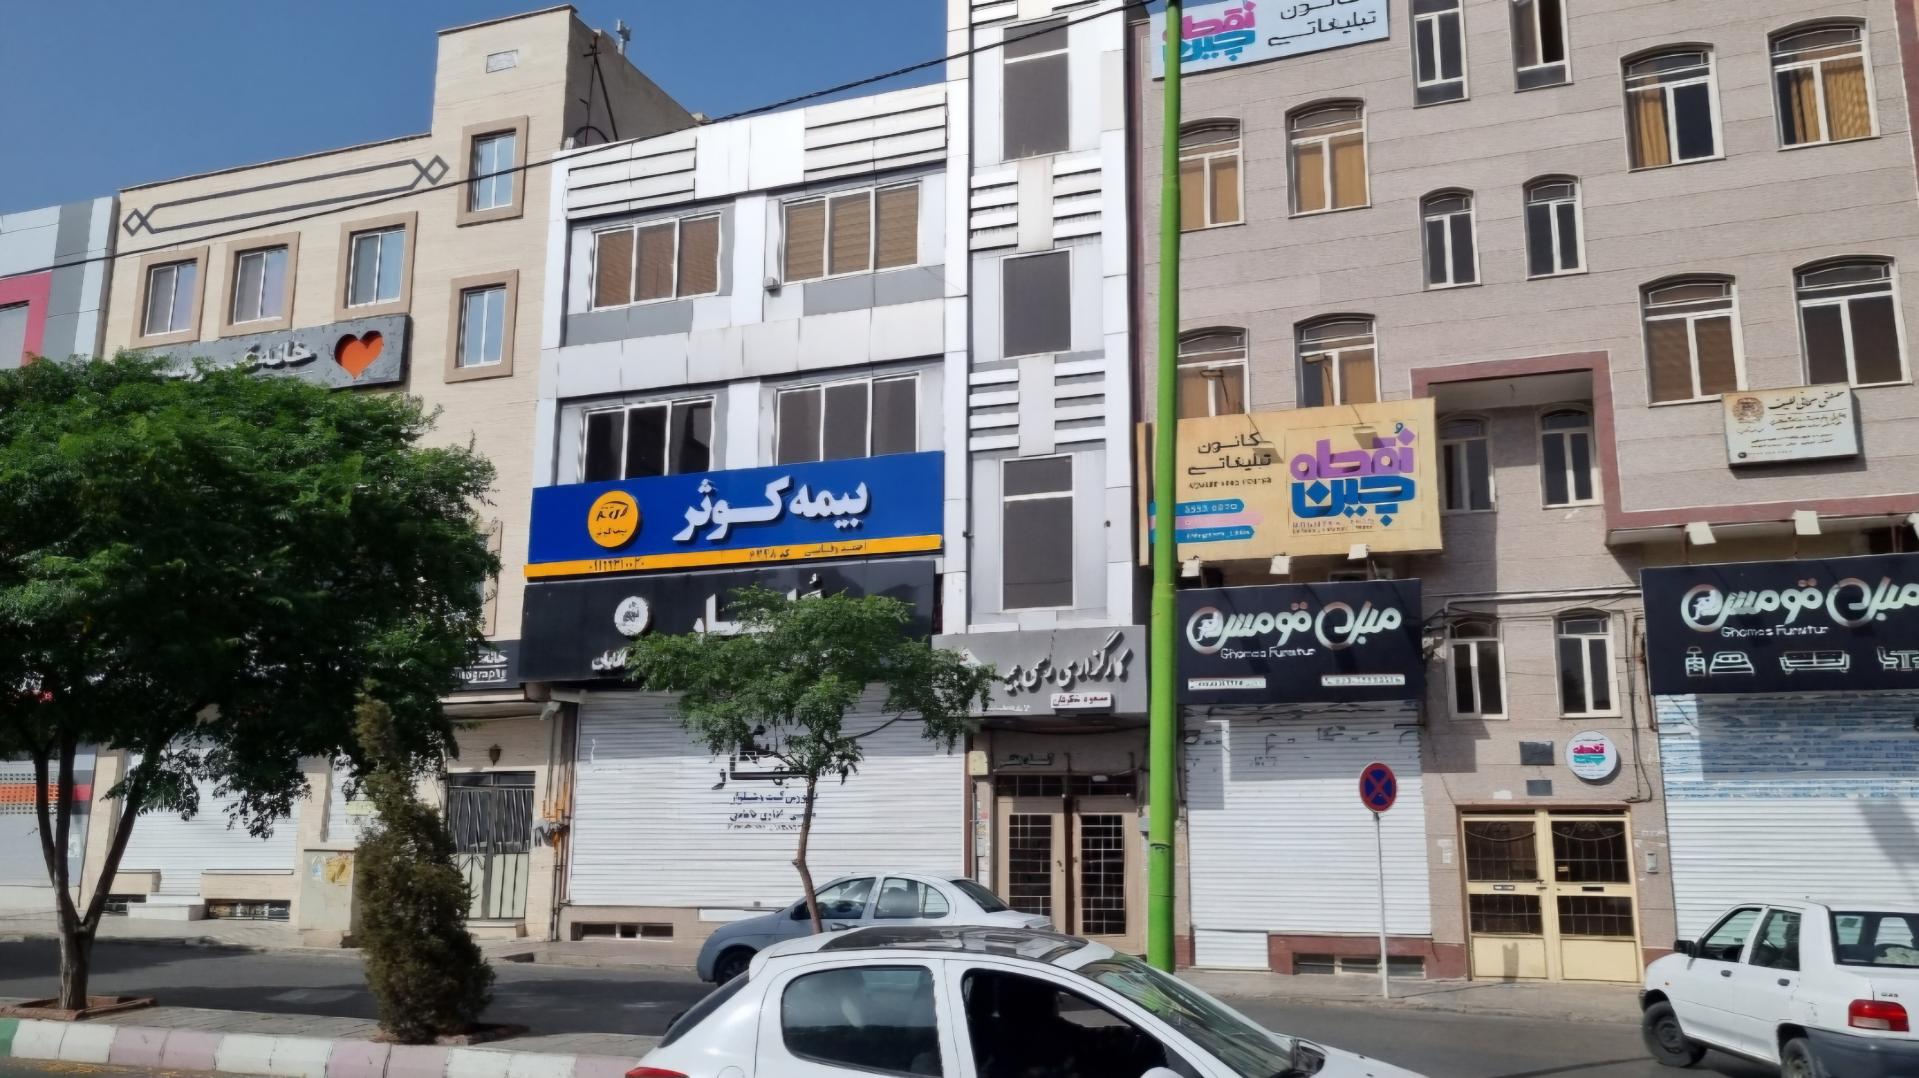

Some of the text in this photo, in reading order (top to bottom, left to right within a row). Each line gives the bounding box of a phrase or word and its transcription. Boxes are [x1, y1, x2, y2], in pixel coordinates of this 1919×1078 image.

[1163, 0, 1256, 41] نقط
[1267, 10, 1377, 47] تبلیغاتی
[1198, 431, 1260, 454] کانون
[1290, 424, 1416, 481] نقطه
[1187, 453, 1272, 476] تبلیغاتی
[672, 475, 869, 542] بیمه کوثر
[1291, 475, 1416, 527] چین
